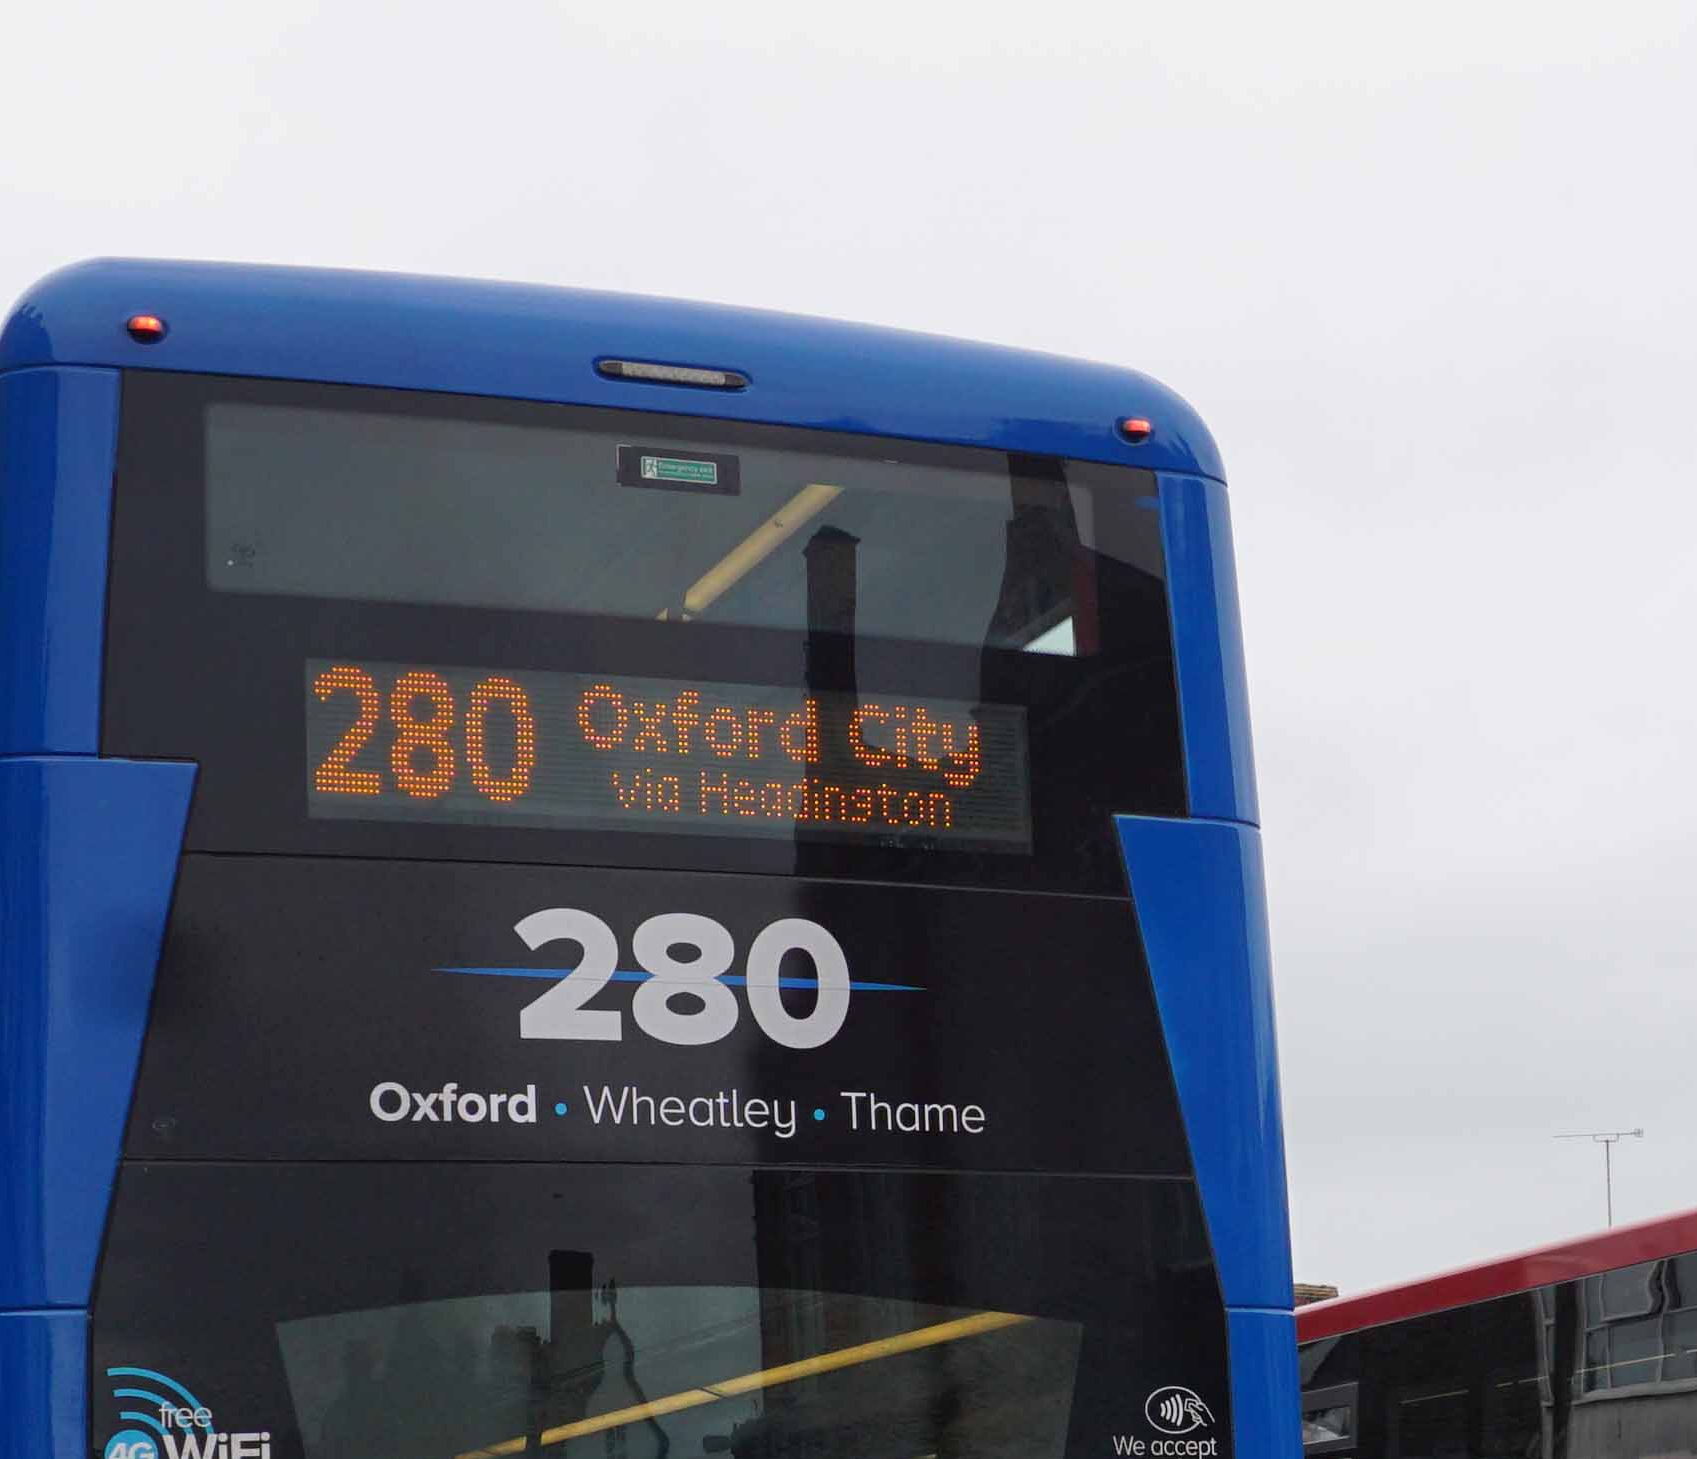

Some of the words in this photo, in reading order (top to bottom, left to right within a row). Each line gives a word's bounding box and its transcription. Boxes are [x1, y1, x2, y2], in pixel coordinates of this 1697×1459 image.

[313, 665, 535, 803] 280
[576, 683, 819, 763] Oxford
[848, 703, 981, 789] City
[613, 766, 680, 814] via
[698, 770, 953, 829] Headington
[512, 906, 852, 1050] 280
[369, 1081, 537, 1125] Oxford
[582, 1085, 798, 1139] Wheatley
[840, 1091, 987, 1136] Thame
[158, 1402, 213, 1429] free
[1113, 1435, 1146, 1456] We
